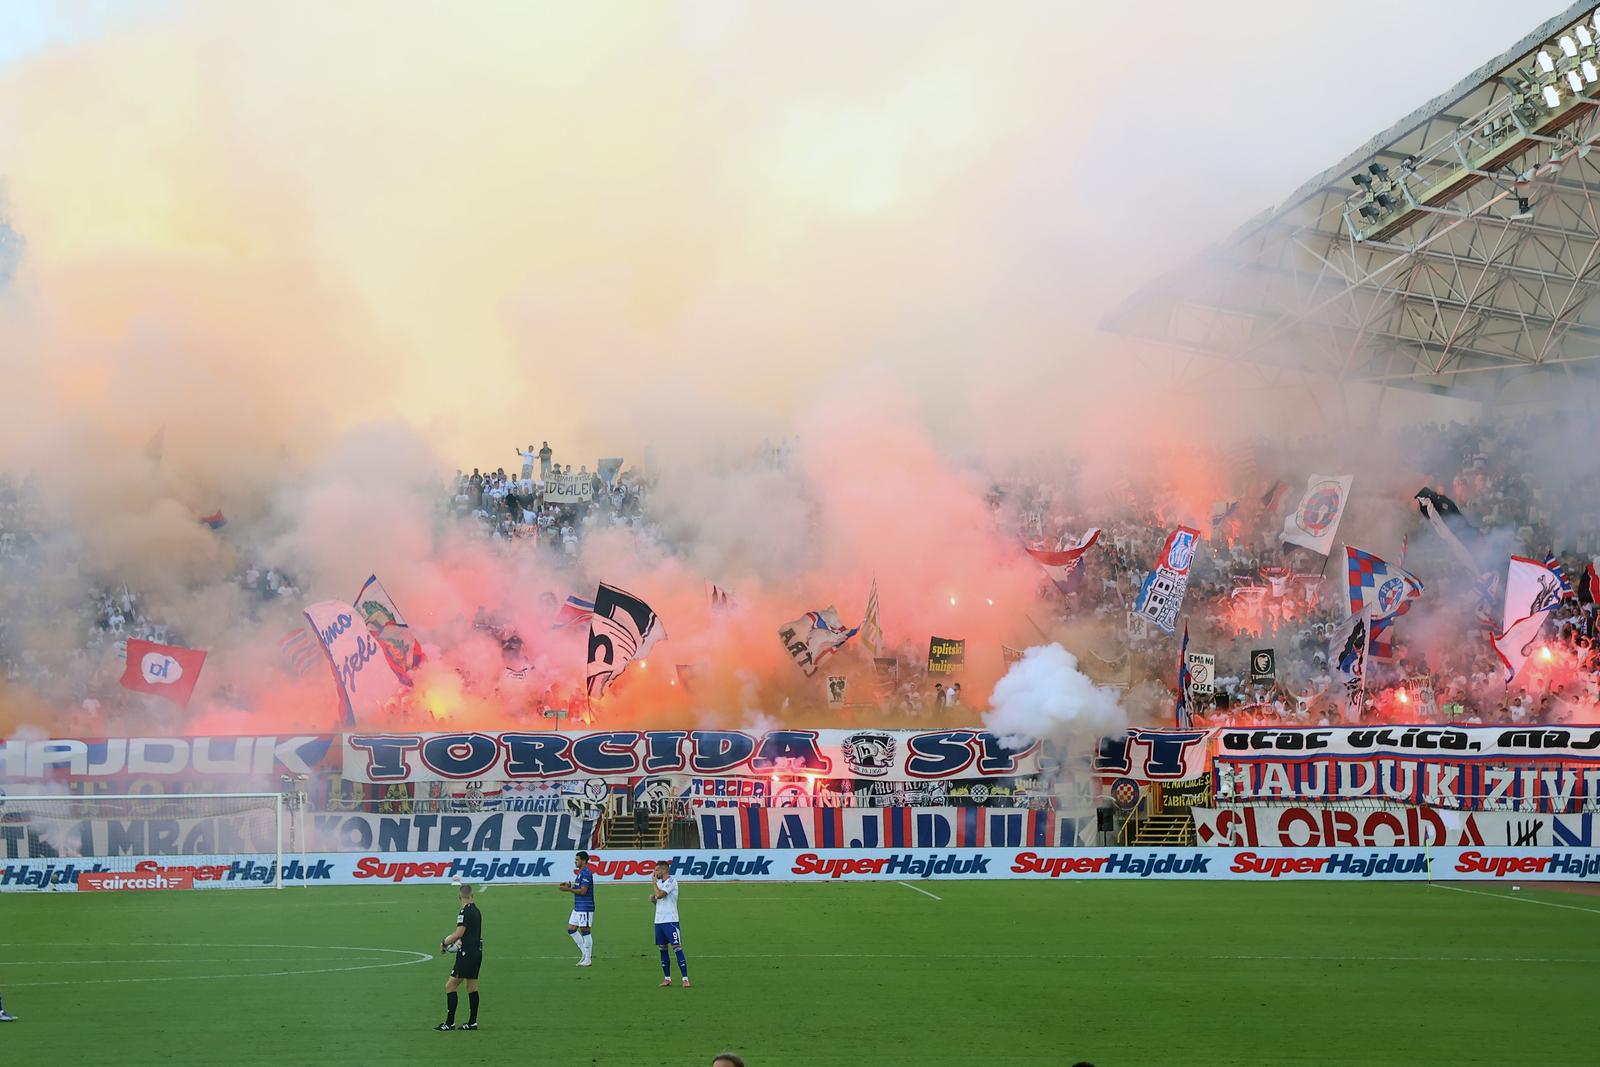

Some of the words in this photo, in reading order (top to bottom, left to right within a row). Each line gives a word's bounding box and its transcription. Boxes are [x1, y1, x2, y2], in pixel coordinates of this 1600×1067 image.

[932, 643, 962, 657] splitski
[348, 730, 833, 779] TORCIDA
[1214, 759, 1460, 808] HAJDUK
[315, 814, 504, 851] KONTRA
[102, 875, 170, 890] aircash
[352, 856, 555, 883] SuperHajduk
[574, 853, 774, 881] SupeHajduk
[791, 852, 992, 880] SuperHajduk
[1010, 852, 1212, 877] SuperHajduk
[1230, 851, 1434, 877] SuperHajduk
[1454, 851, 1600, 877] SuperHajd
